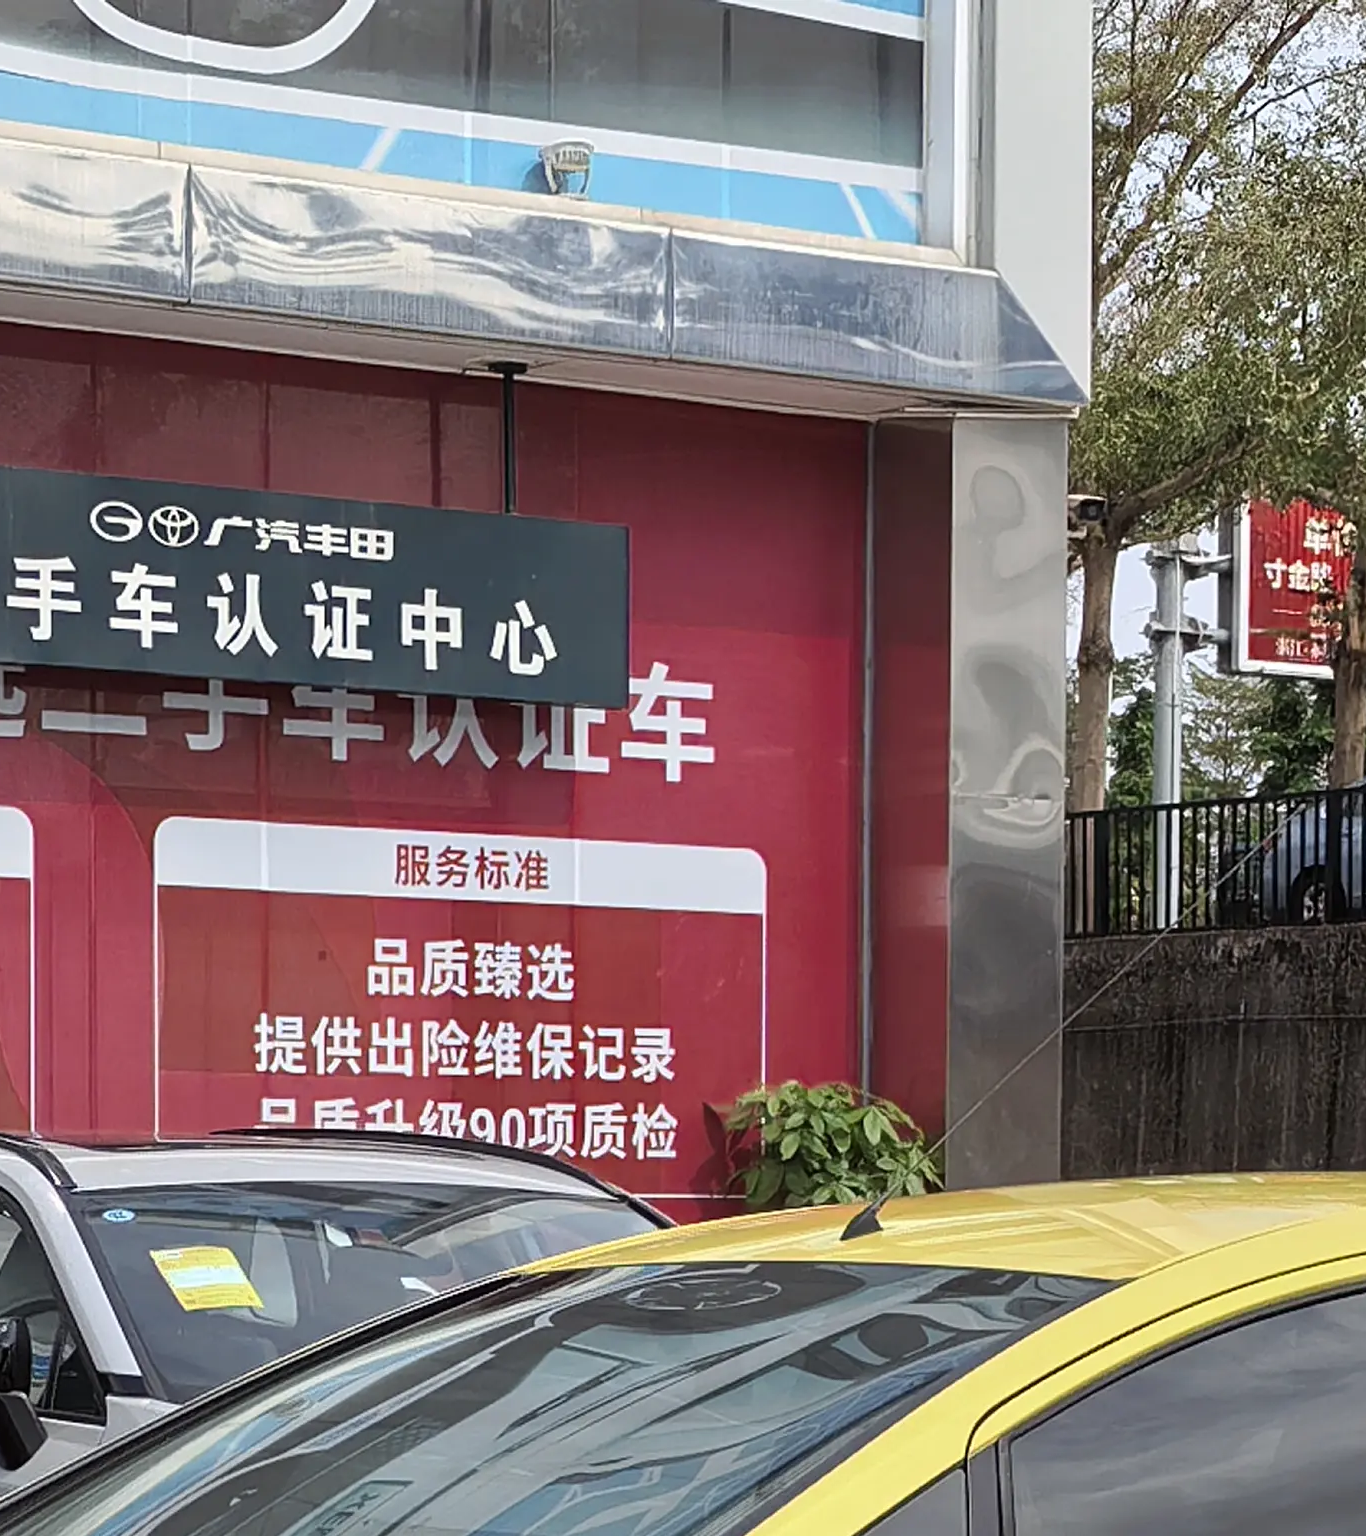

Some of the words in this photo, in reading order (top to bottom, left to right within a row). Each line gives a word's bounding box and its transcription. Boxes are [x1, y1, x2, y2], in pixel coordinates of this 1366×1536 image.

[204, 516, 395, 561] 广汽丰田
[394, 844, 551, 892] 服务标准
[366, 938, 575, 1003] 品质臻选
[253, 1013, 678, 1085] 提供出险维保记录
